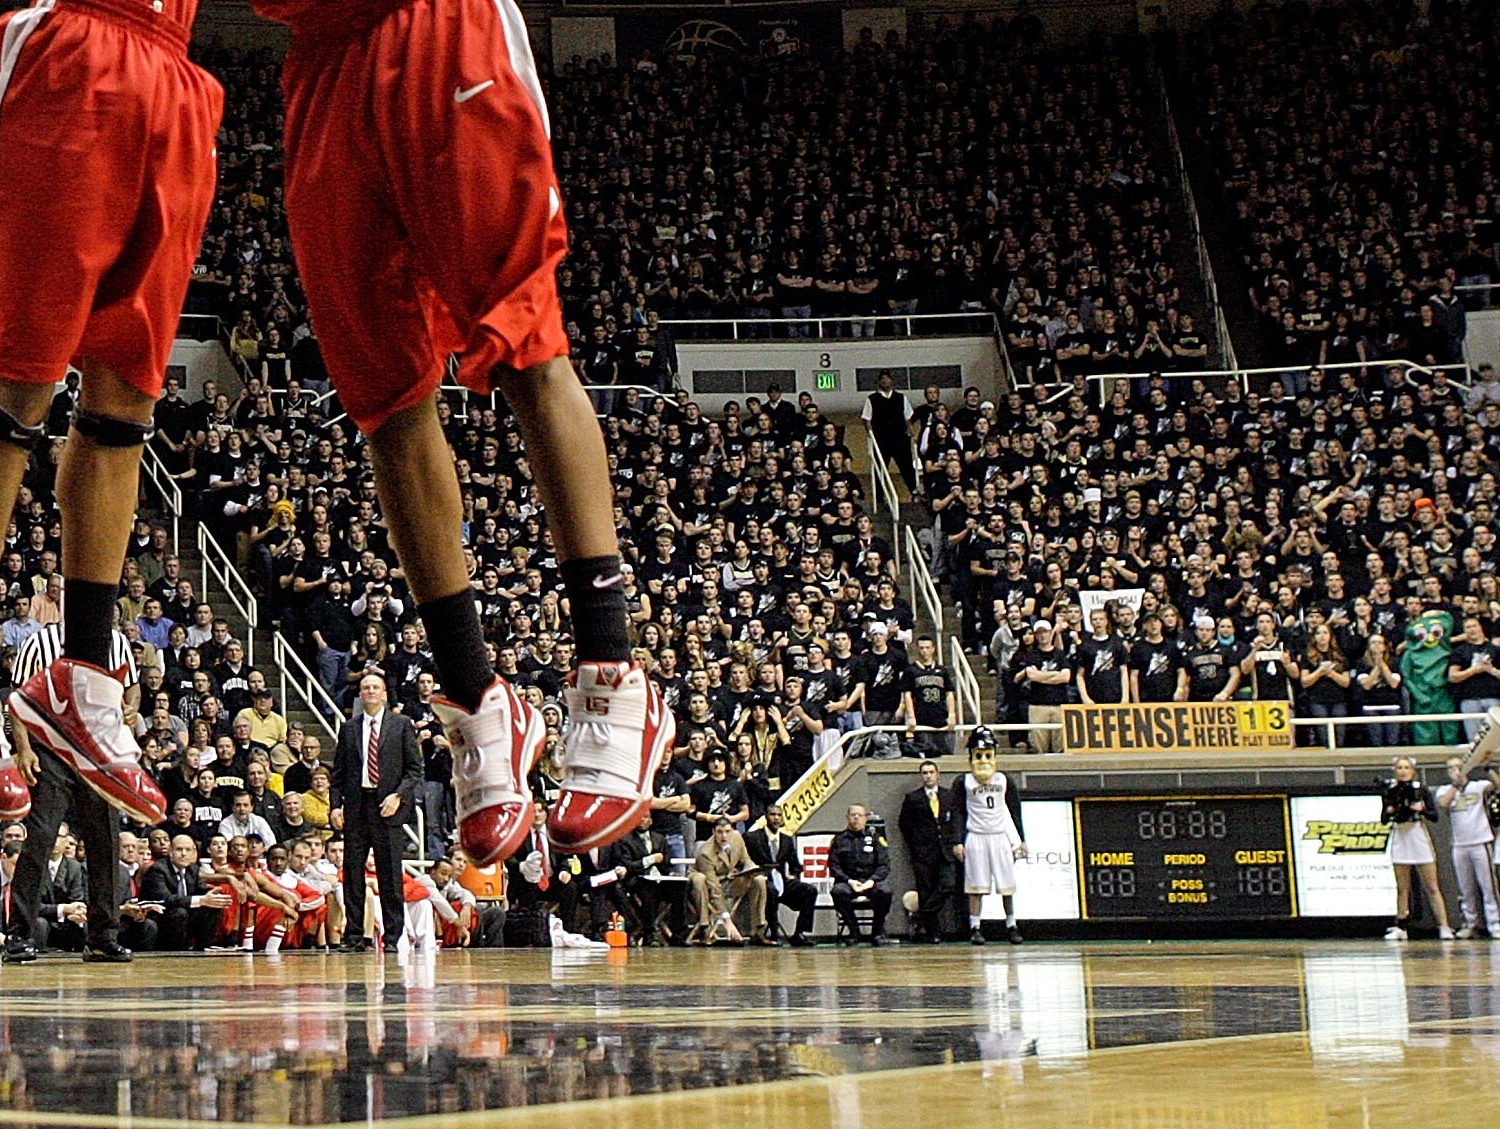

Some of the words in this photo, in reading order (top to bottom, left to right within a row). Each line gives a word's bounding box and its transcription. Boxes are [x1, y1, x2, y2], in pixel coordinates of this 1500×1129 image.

[820, 353, 831, 368] 8
[1192, 706, 1237, 726] LIVES
[1064, 706, 1190, 750] DEFENSE
[1195, 727, 1240, 749] HERE
[986, 796, 995, 809] 0
[1318, 833, 1387, 854] PRIDE
[1090, 853, 1135, 867] HOME
[1164, 854, 1206, 866] PERIOD
[1235, 851, 1286, 865] GUEST
[1171, 879, 1205, 891] POSS
[1168, 892, 1208, 904] BONUS
